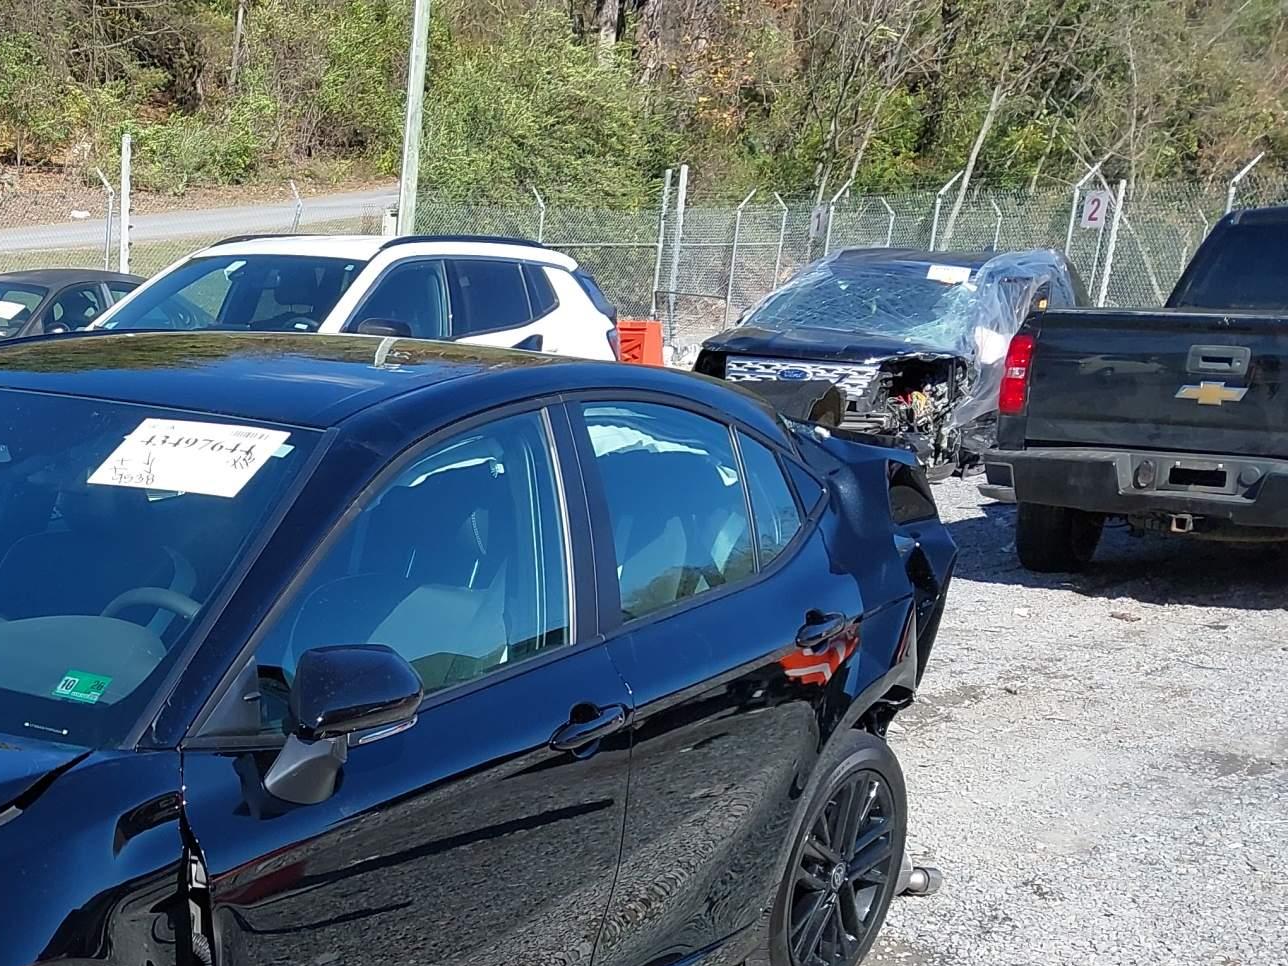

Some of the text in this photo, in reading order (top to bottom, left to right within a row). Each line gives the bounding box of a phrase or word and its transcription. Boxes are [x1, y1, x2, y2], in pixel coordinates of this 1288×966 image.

[1088, 198, 1101, 221] 2
[816, 212, 821, 231] 1
[140, 434, 257, 456] 43497644
[60, 678, 76, 691] 10
